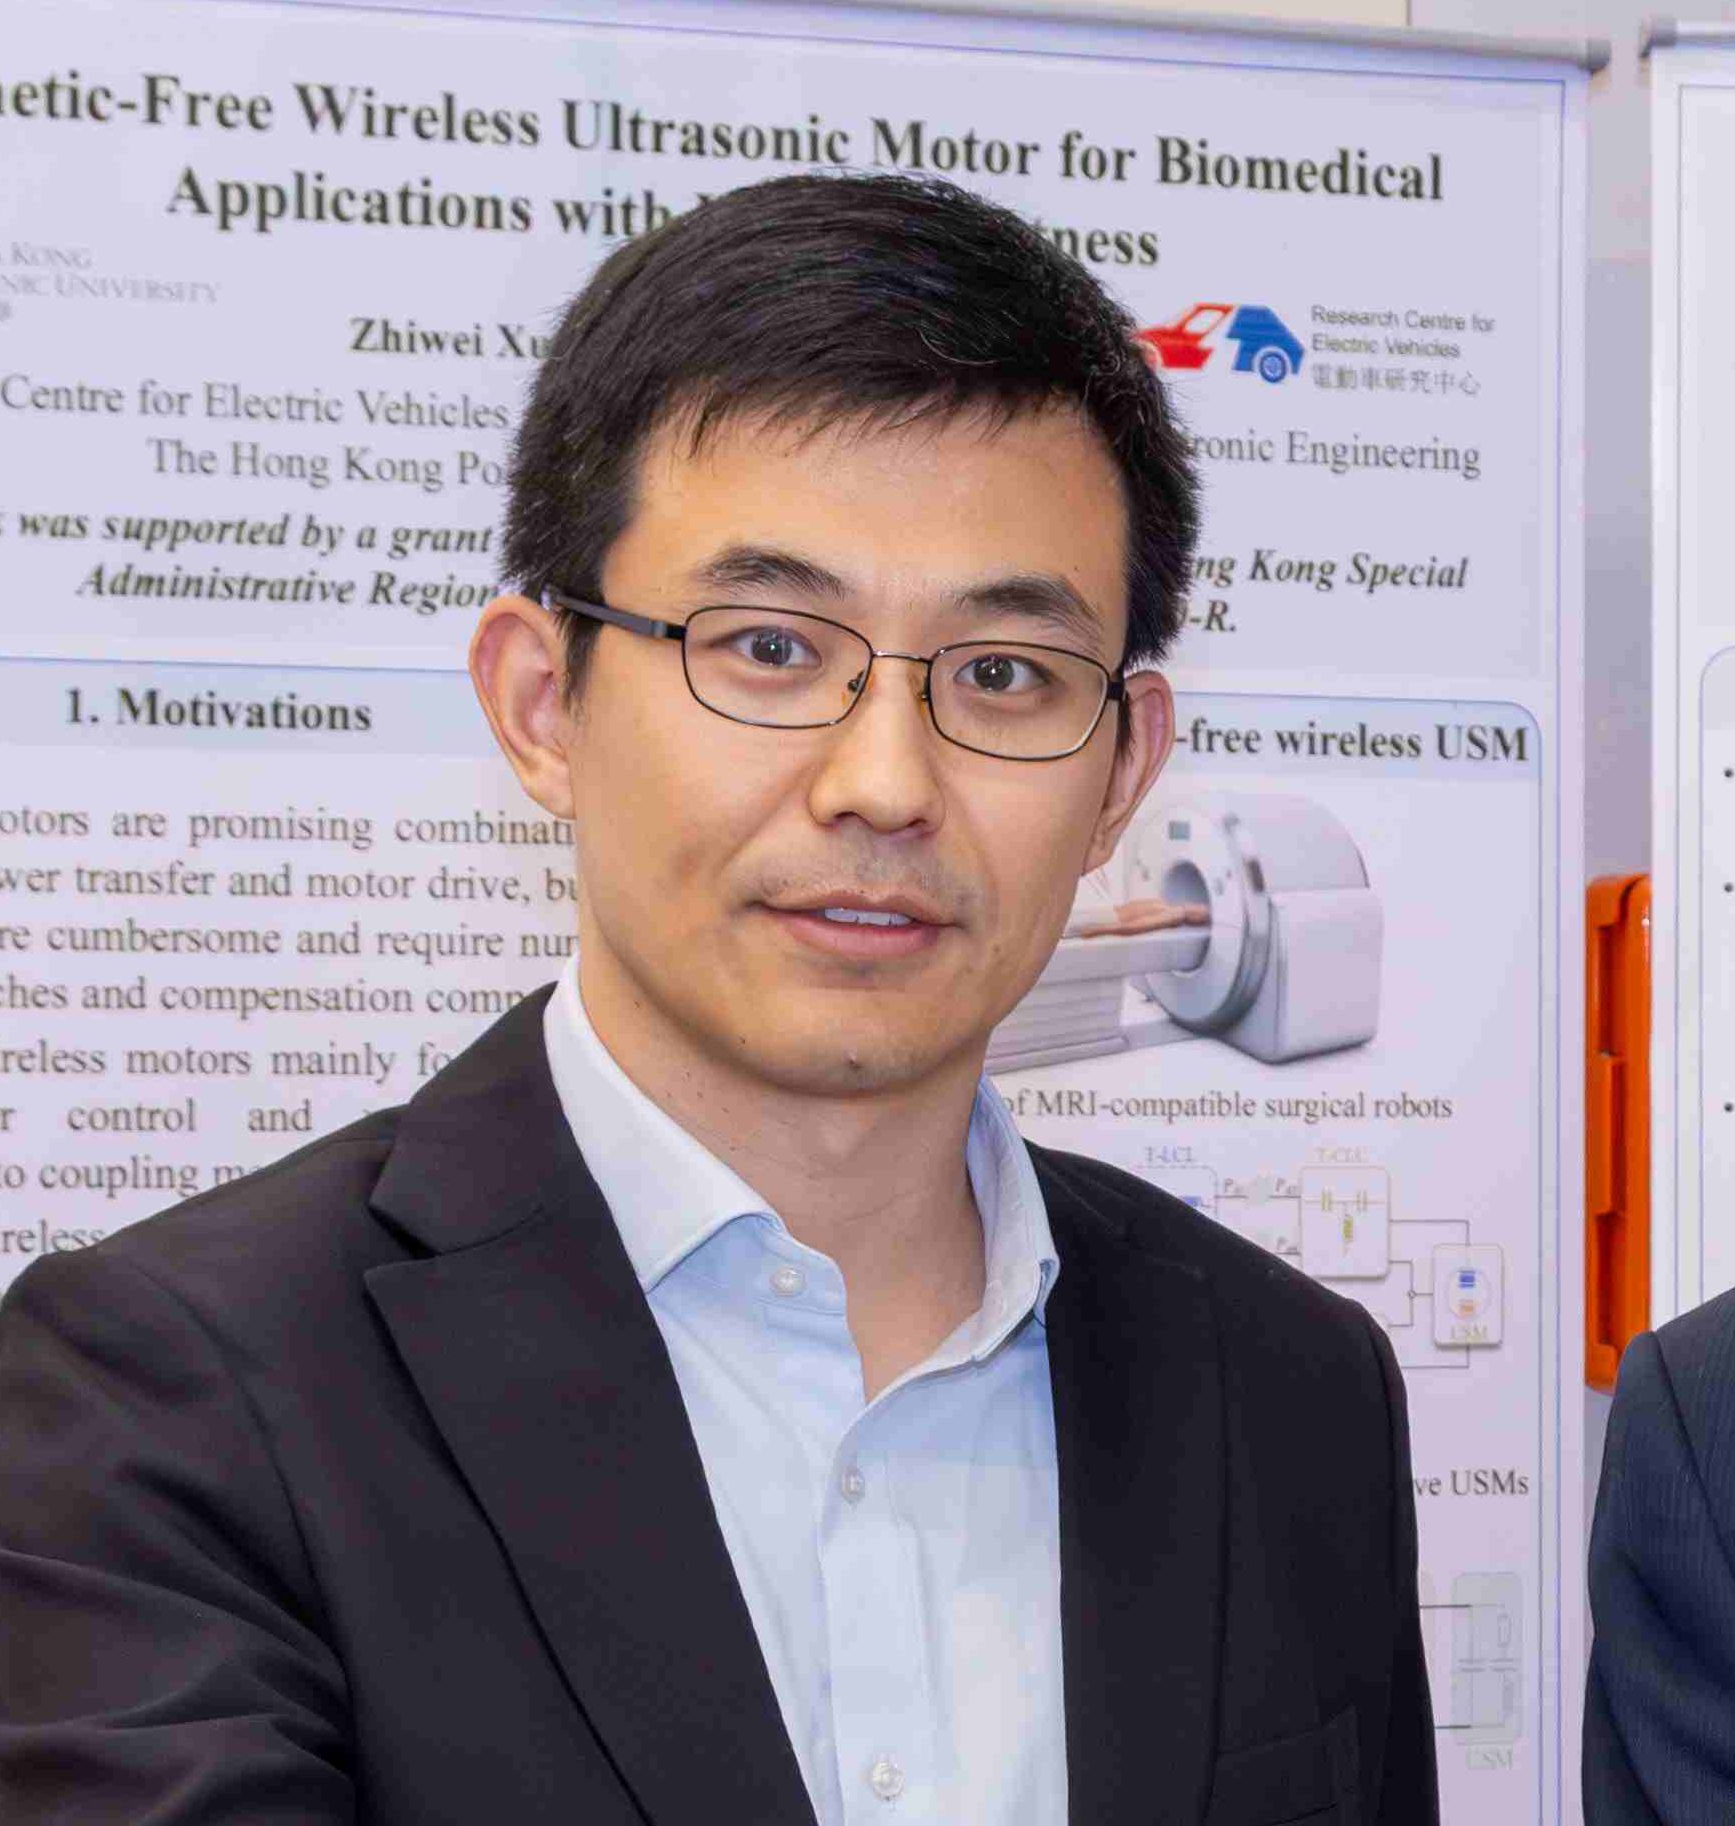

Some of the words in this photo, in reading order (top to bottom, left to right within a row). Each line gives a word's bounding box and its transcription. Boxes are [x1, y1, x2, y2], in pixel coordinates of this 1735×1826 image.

[295, 84, 539, 146] Wireless
[564, 100, 848, 163] Ultrasonic
[873, 119, 1040, 175] Motor
[1060, 131, 1136, 181] for
[1158, 137, 1442, 200] Biomedical
[169, 168, 531, 233] Applications
[0, 375, 124, 413] Centre
[139, 380, 192, 416] for
[204, 382, 343, 424] Electric
[357, 390, 509, 429] Vehicles
[20, 515, 88, 538] was
[103, 514, 290, 553] supported
[300, 514, 344, 556] by
[356, 527, 376, 549] a
[387, 527, 493, 559] grant
[69, 689, 99, 723] 1.
[119, 688, 371, 731] Motivations
[1275, 722, 1422, 758] wireless
[1436, 725, 1527, 761] USM
[1036, 1090, 1257, 1125] MRI-compatible
[1265, 1091, 1365, 1125] surgical
[1374, 1092, 1453, 1119] robots
[1451, 1469, 1529, 1495] USMs
